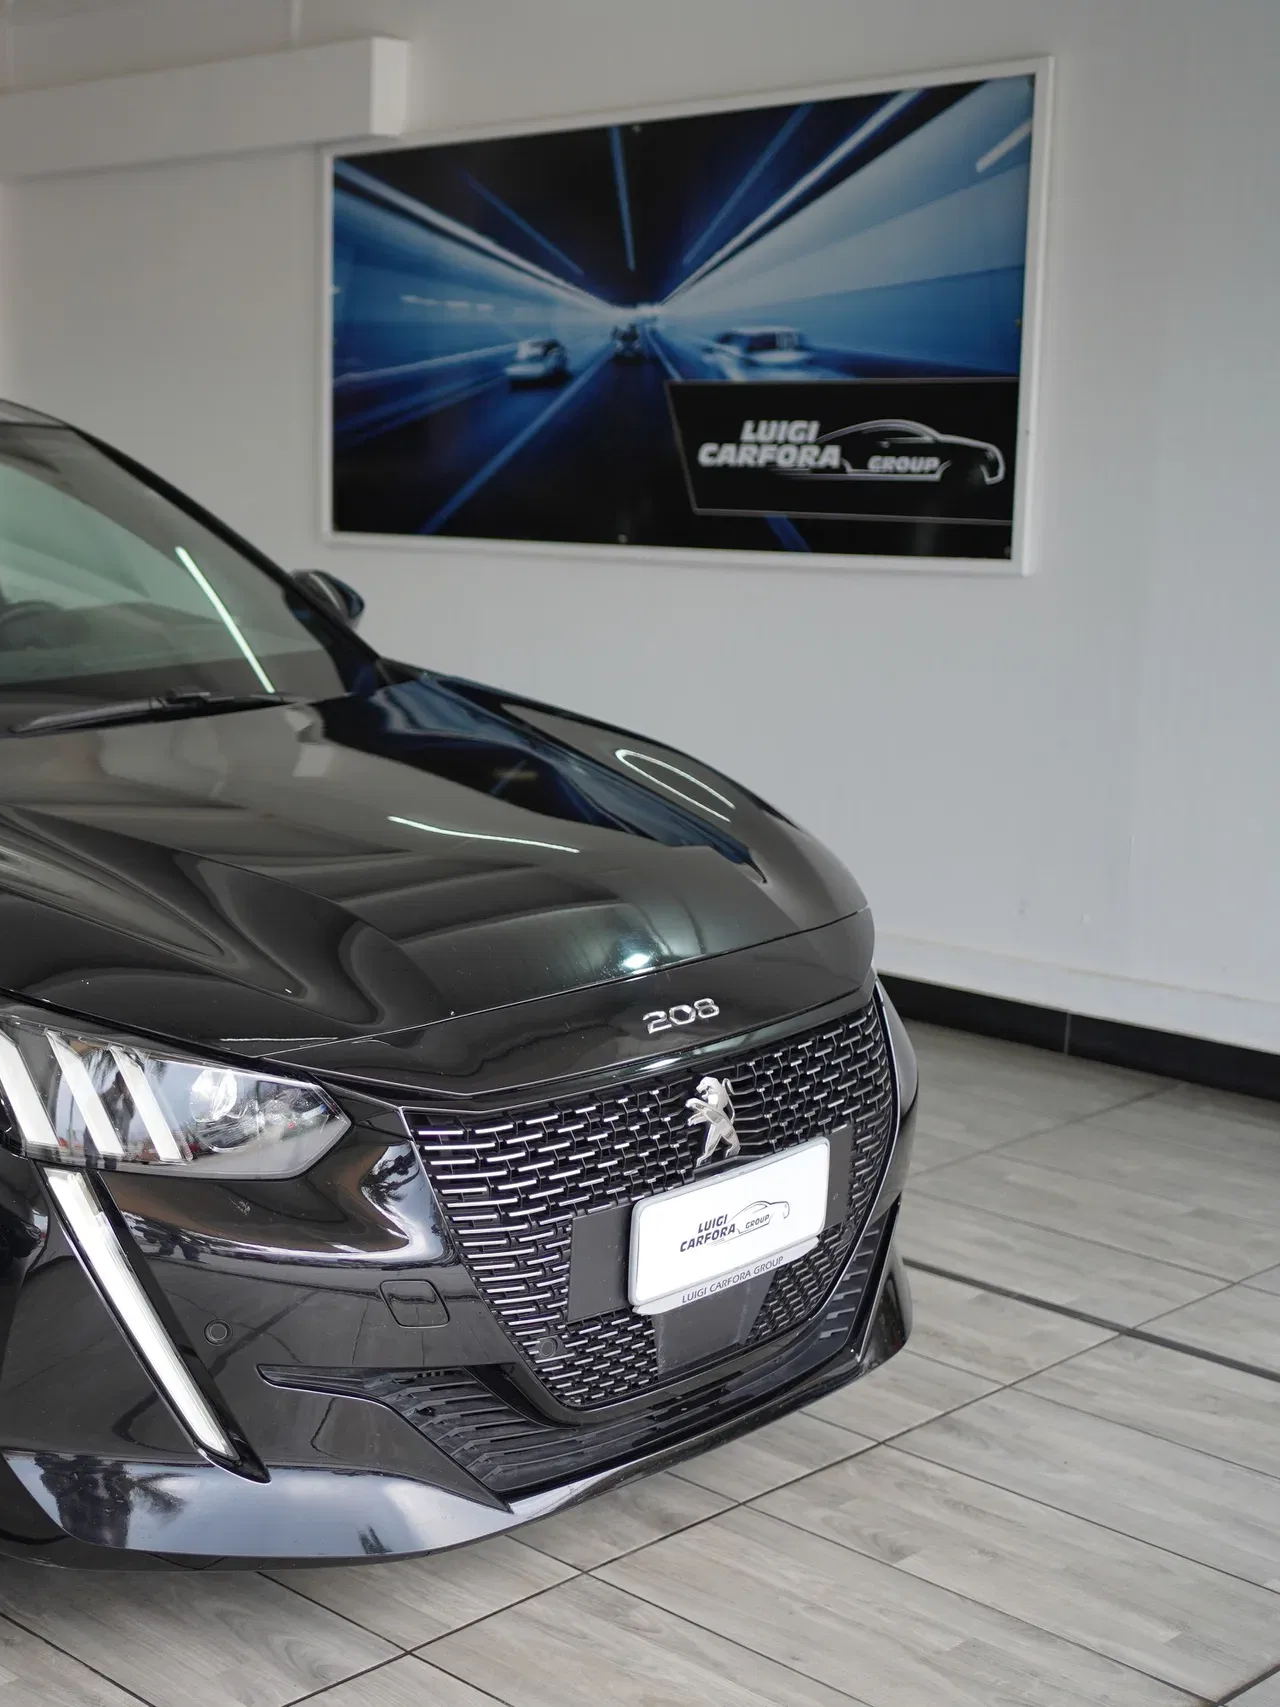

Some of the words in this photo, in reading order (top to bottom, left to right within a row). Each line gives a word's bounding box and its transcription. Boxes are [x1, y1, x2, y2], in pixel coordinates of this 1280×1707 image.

[740, 419, 820, 443] LUIGI
[698, 442, 841, 468] CARFORA
[867, 454, 941, 473] GROUP
[642, 997, 720, 1034] 208
[679, 1223, 736, 1253] CARFORA
[745, 1213, 770, 1229] GROUP
[697, 1213, 728, 1234] LUIGI
[682, 1287, 707, 1304] LUIGI
[709, 1270, 751, 1293] CARFORA
[753, 1255, 784, 1276] GROUP
